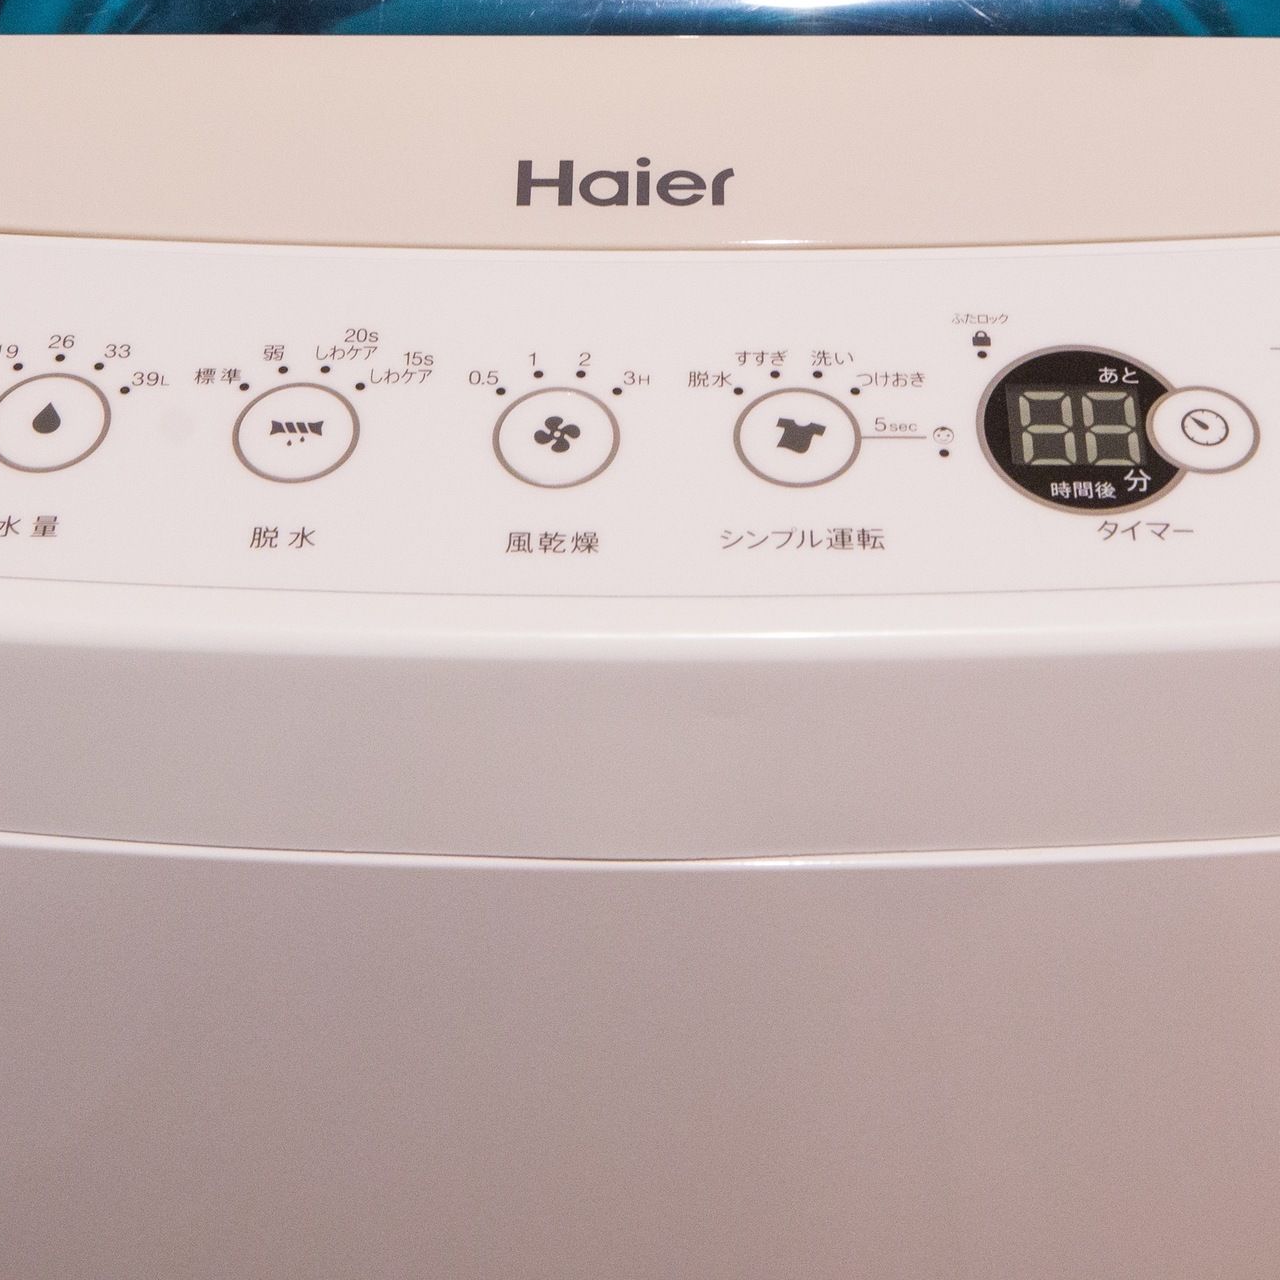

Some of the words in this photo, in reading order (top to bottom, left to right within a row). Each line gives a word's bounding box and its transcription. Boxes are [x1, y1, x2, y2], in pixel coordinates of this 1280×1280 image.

[516, 156, 736, 207] Haier
[950, 311, 1010, 325] ふたロック
[48, 334, 76, 349] 26
[345, 328, 380, 343] 20s
[105, 343, 133, 359] 33
[264, 344, 286, 361] 弱
[316, 345, 379, 361] しわケア
[404, 351, 435, 367] 15s
[527, 351, 539, 367] 1
[577, 351, 593, 367] 2
[736, 350, 787, 367] すすぎ
[812, 350, 855, 366] 洗い
[131, 371, 171, 387] 39L
[194, 367, 243, 385] 標準
[371, 369, 434, 384] しわケア
[467, 369, 500, 386] 0.5
[622, 370, 651, 386] 3H
[687, 371, 734, 389] 脱水
[855, 371, 927, 388] つけおき
[1097, 366, 1141, 385] あと
[873, 416, 919, 433] 5sec
[1123, 468, 1152, 492] 分
[1050, 480, 1117, 499] 時間後
[250, 526, 317, 549] 脱水
[722, 527, 886, 550] シンプル運転
[1099, 520, 1195, 541] タイマー
[506, 531, 600, 554] 風乾燥
